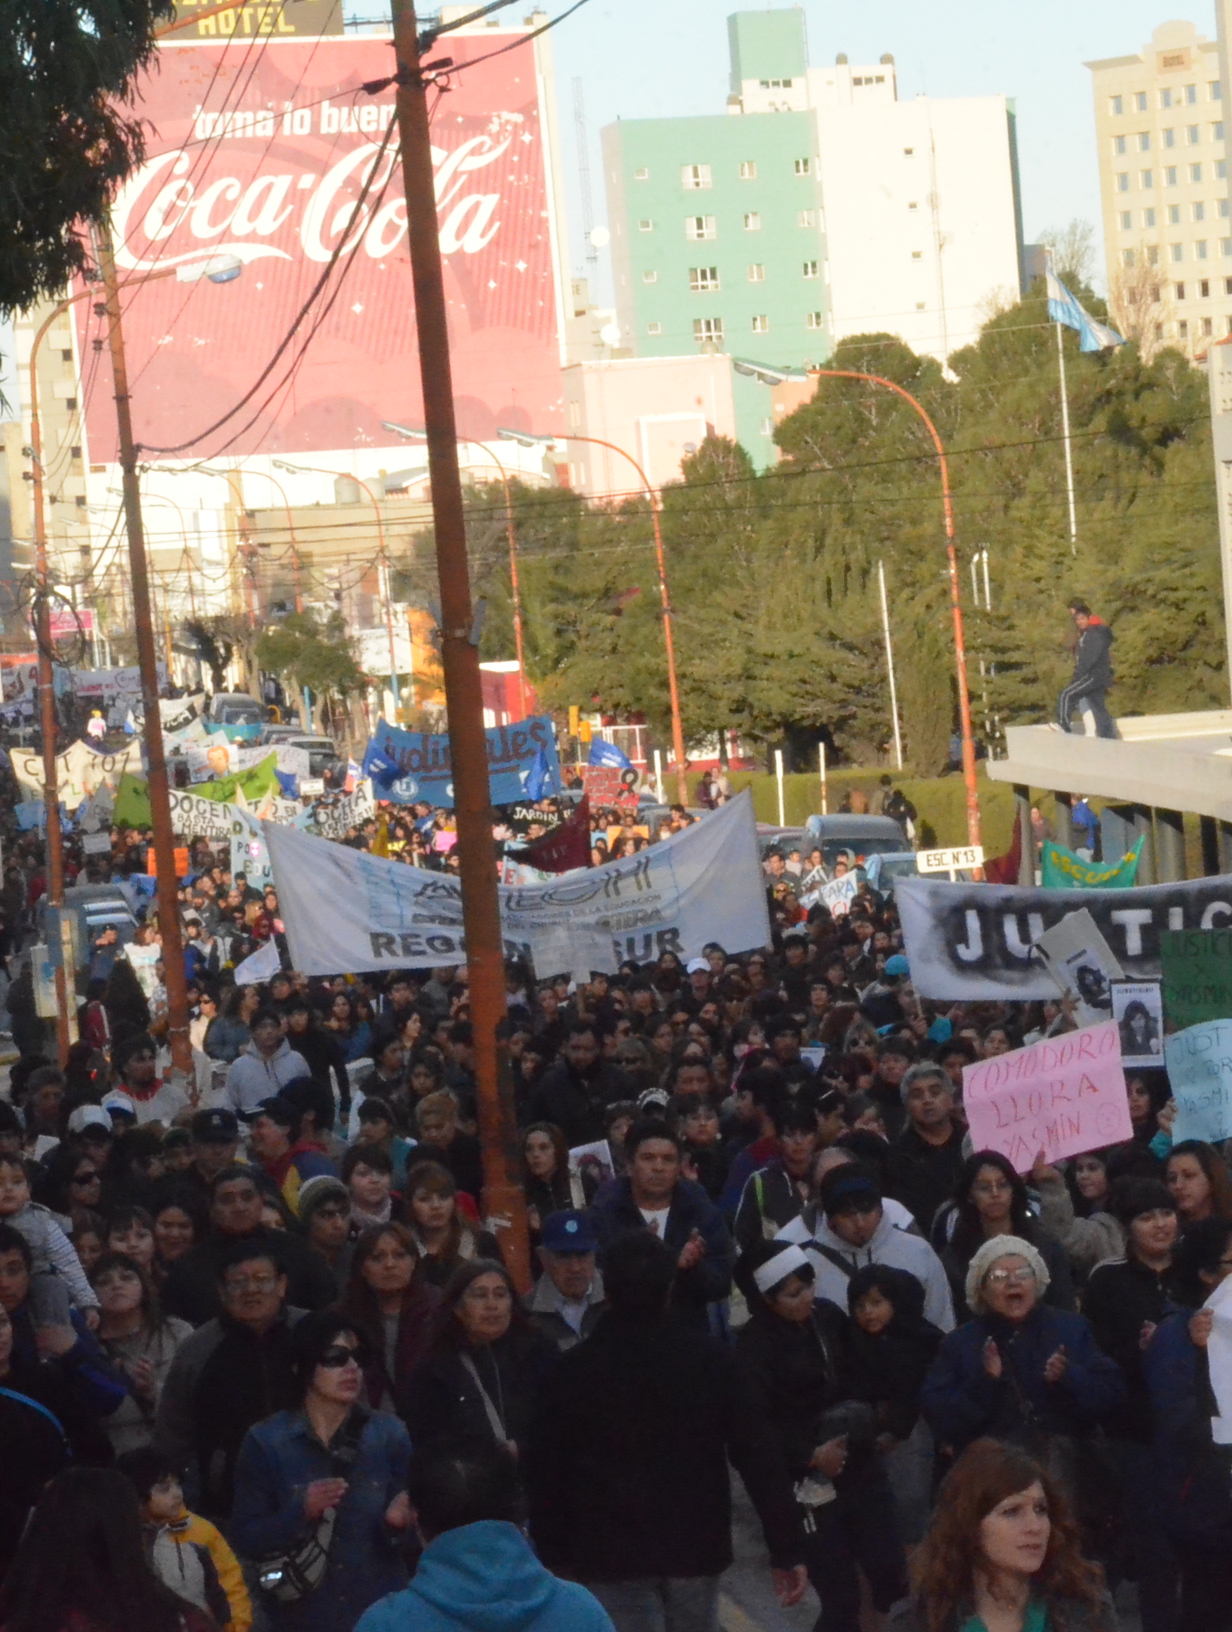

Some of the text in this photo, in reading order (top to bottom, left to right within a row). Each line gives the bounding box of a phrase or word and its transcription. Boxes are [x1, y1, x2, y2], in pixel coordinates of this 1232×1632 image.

[198, 6, 296, 36] HOTEL
[282, 101, 312, 135] lo
[926, 852, 949, 867] ESC
[968, 1030, 1116, 1099] COMODORO
[991, 1073, 1099, 1129] LLORA
